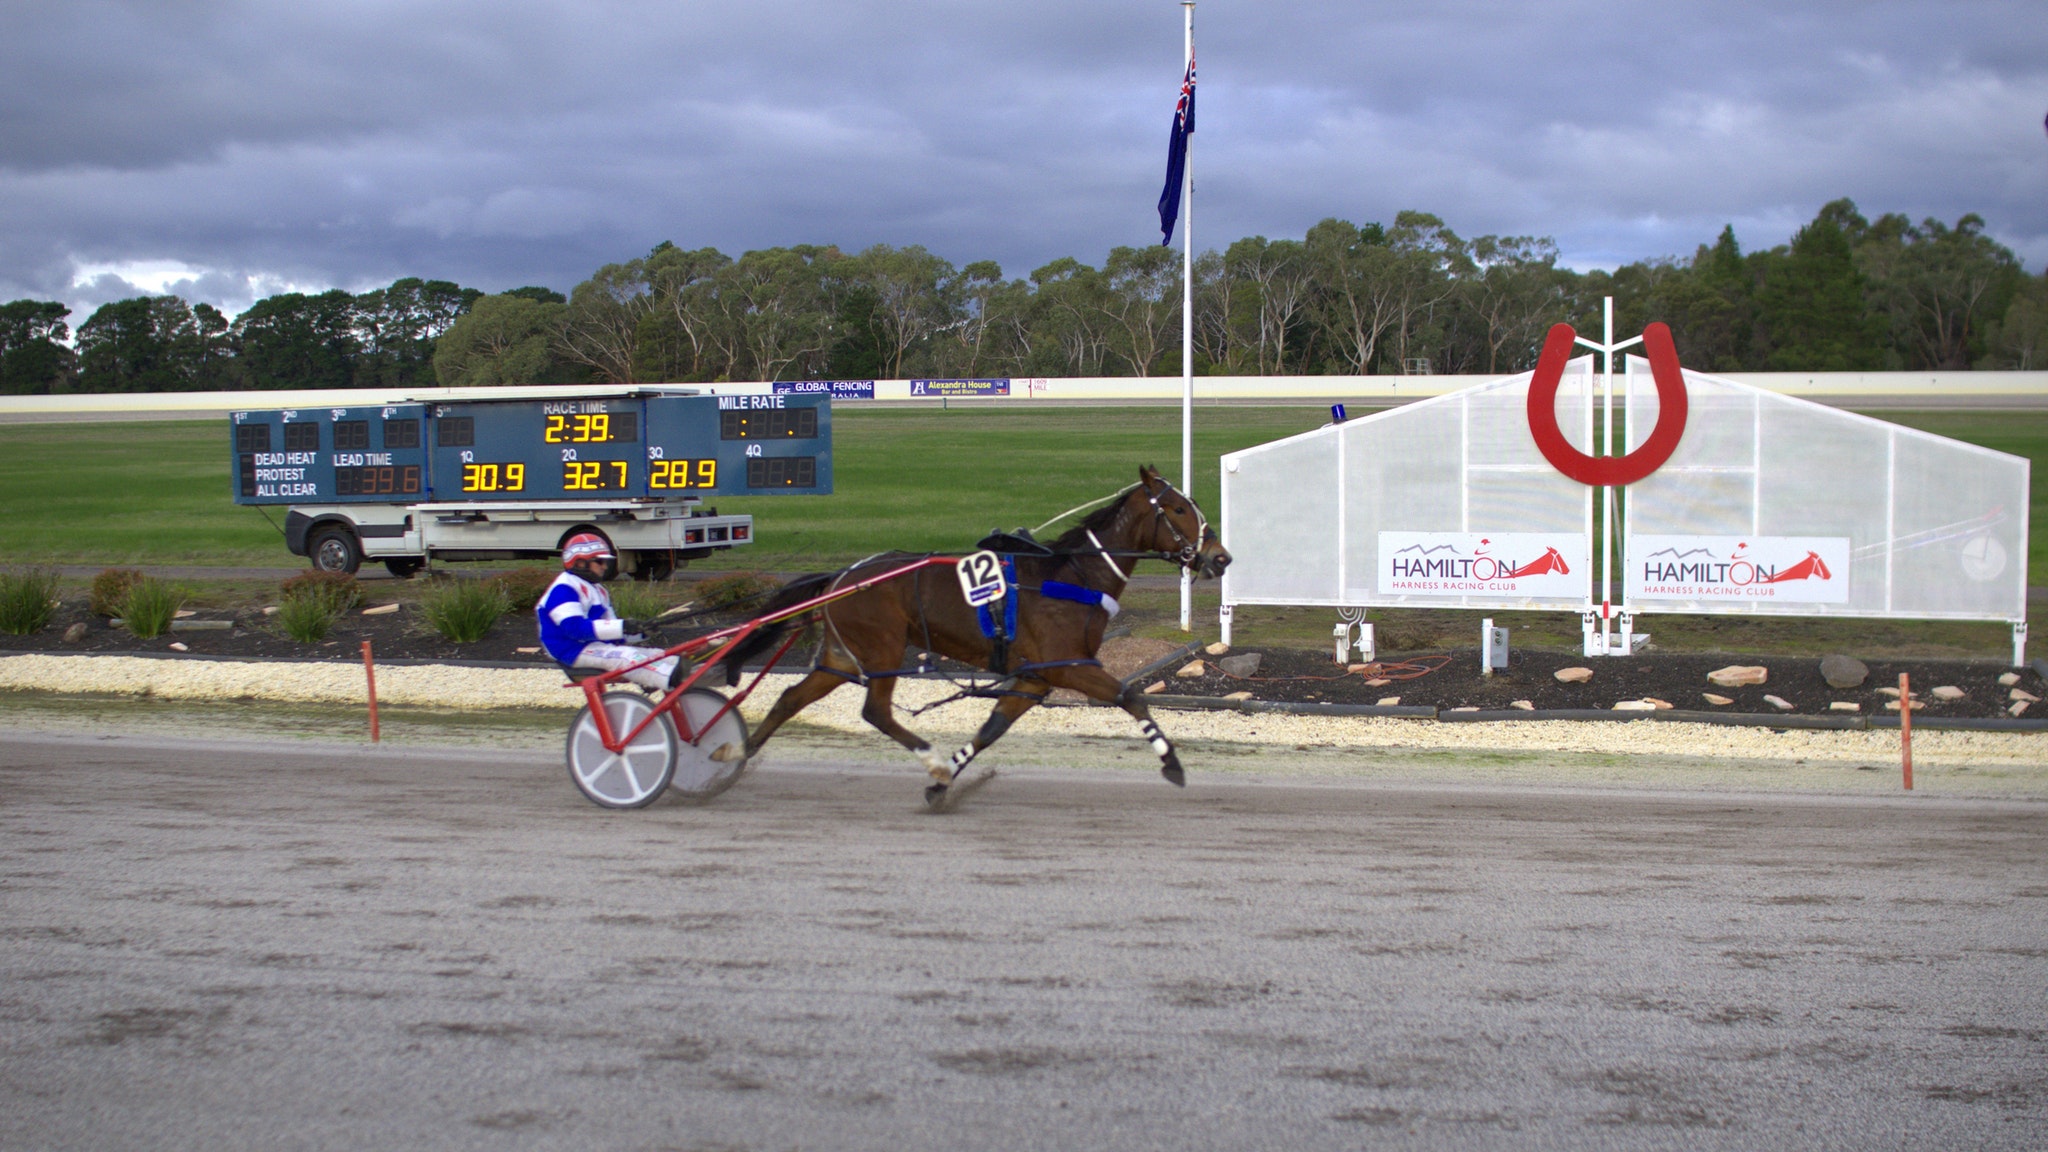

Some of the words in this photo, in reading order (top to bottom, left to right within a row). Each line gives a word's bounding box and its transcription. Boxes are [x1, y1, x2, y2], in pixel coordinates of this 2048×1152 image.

[795, 382, 830, 392] GLOBAL
[833, 381, 872, 391] FENCING
[928, 381, 966, 389] Alexandra
[968, 381, 991, 389] House
[543, 403, 577, 415] RACE
[579, 401, 608, 413] TIME
[718, 397, 748, 410] MILE
[751, 395, 785, 408] RATE
[461, 451, 473, 463] 1Q
[561, 449, 577, 461] 2Q
[649, 447, 663, 459] 3Q
[746, 444, 761, 457] 4Q
[255, 453, 285, 466] DEAD
[288, 452, 316, 465] HEAT
[334, 454, 363, 467] LEAD
[366, 453, 392, 465] TIME
[255, 468, 305, 481] PROTEST
[462, 463, 524, 491] 30.9
[563, 461, 627, 489] 32.7
[650, 459, 716, 488] 28.9
[257, 485, 276, 497] ALL
[279, 483, 316, 496] CLEAR
[961, 554, 999, 589] 12
[1392, 556, 1516, 581] HAMILTON
[1645, 561, 1775, 586] HAMILTON
[1392, 581, 1439, 590] HARNESS
[1443, 582, 1484, 591] RACING
[1489, 582, 1516, 591] CLUB
[1644, 585, 1693, 594] HARNESS
[1698, 587, 1741, 595] RACING
[1746, 588, 1775, 596] CLUB
